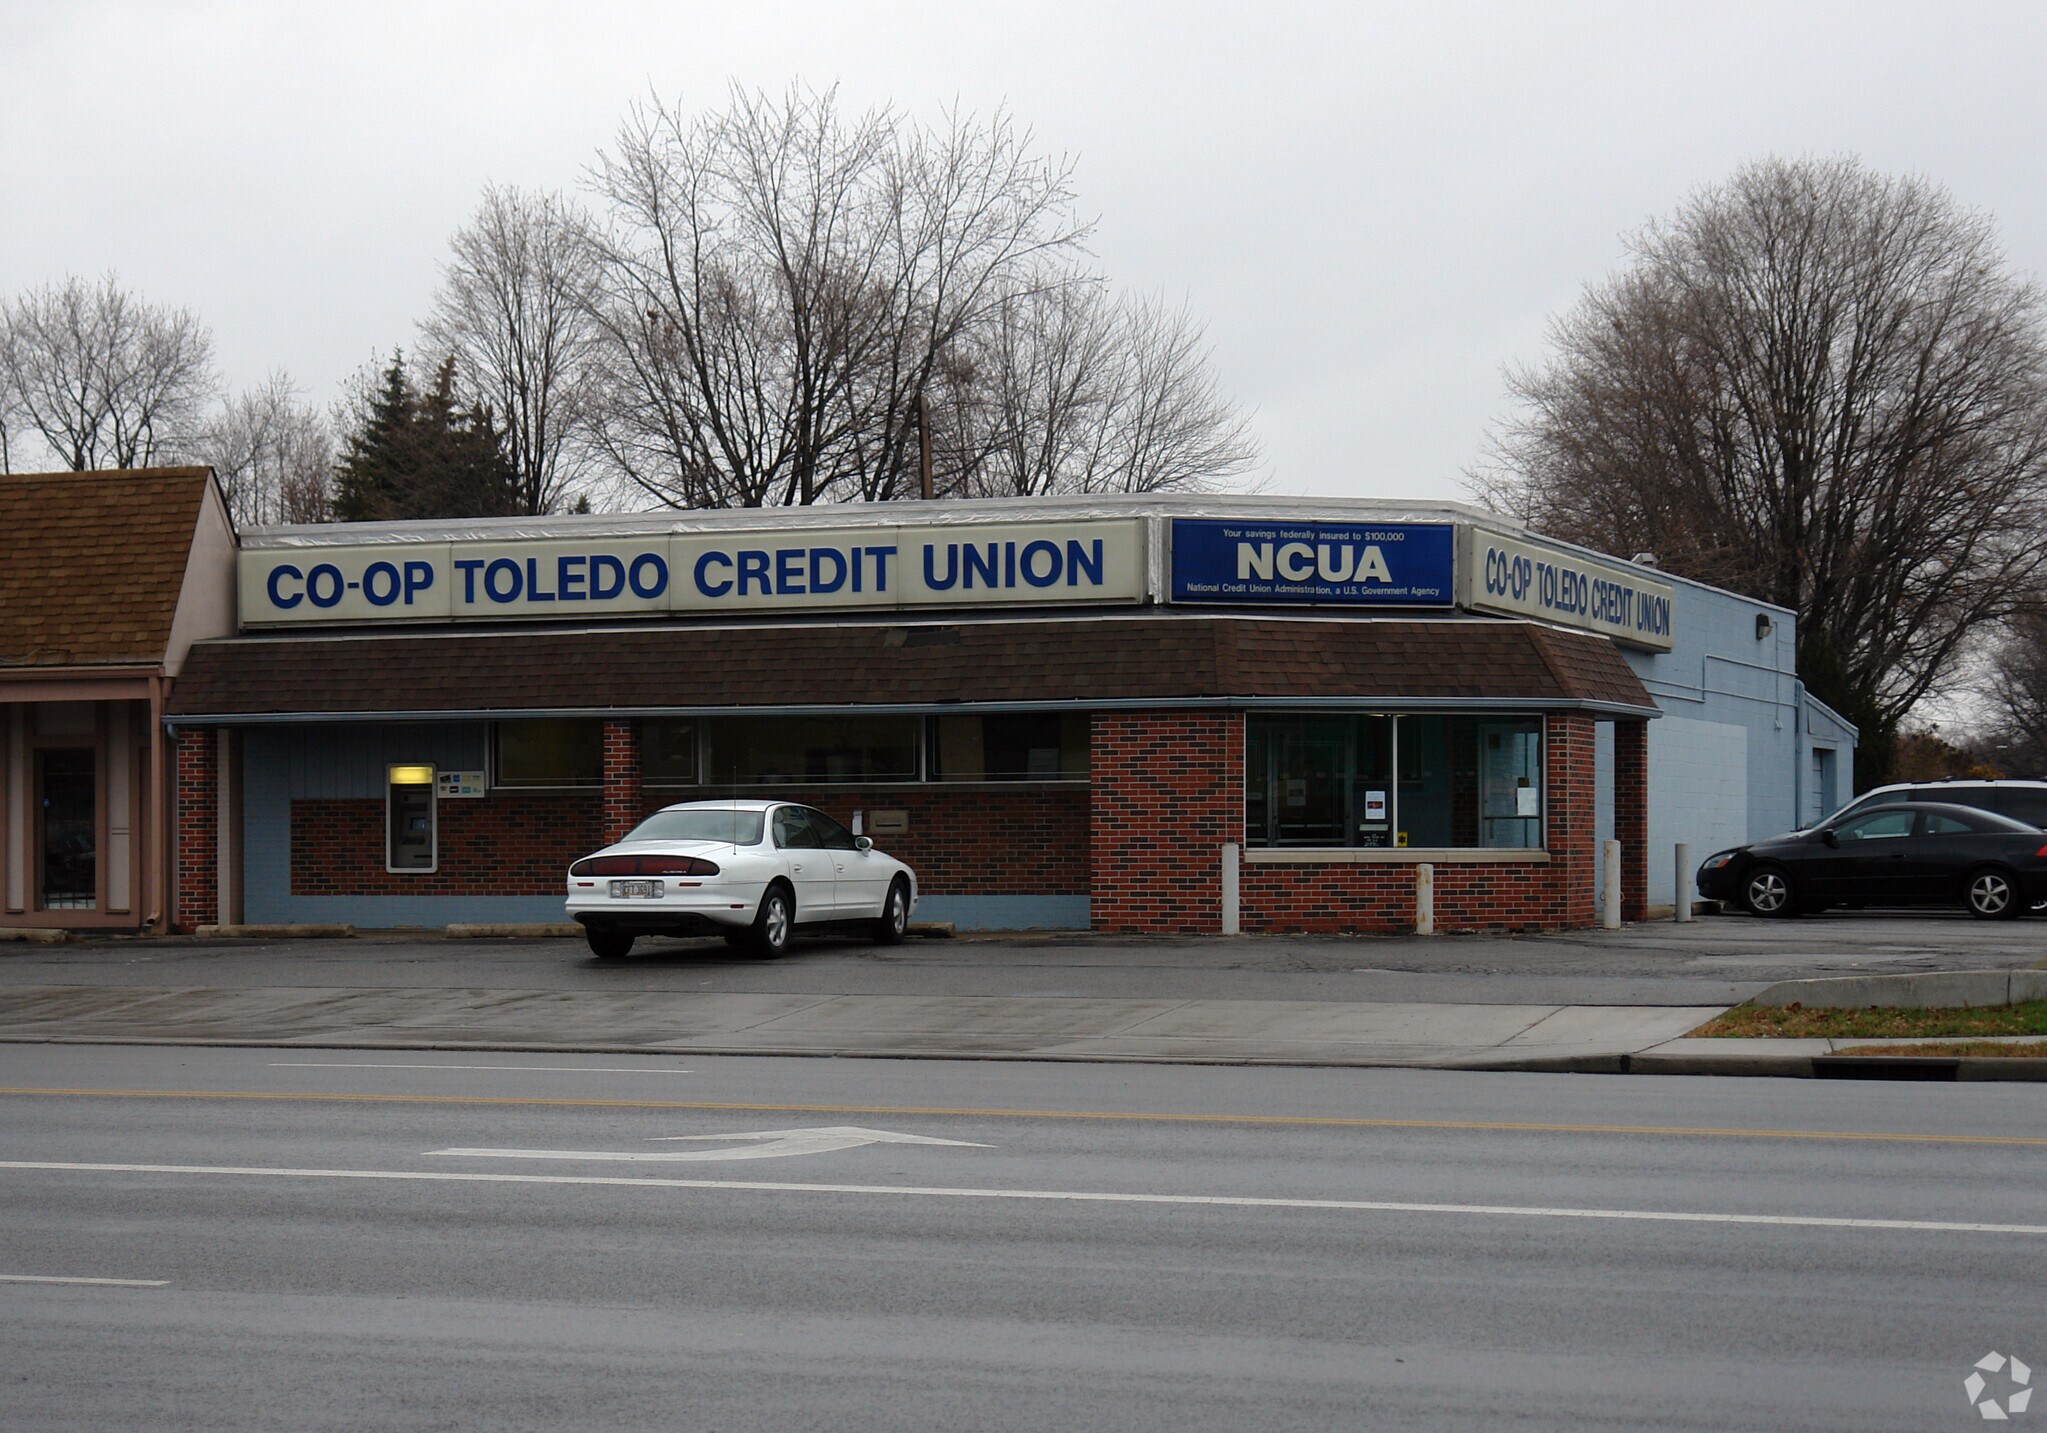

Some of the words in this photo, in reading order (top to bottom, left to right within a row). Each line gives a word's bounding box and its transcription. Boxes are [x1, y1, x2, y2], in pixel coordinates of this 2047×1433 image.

[1223, 529, 1241, 538] Your
[1245, 530, 1276, 540] savings
[1280, 530, 1315, 540] federally
[1319, 531, 1349, 540] insured
[1352, 532, 1361, 540] to
[1364, 532, 1405, 542] $100,000
[267, 561, 434, 609] CO-OP
[454, 553, 669, 603] TOLEDO
[693, 546, 897, 597] CREDIT
[922, 539, 1103, 591] UNION
[1237, 542, 1393, 583] NCUA
[1187, 583, 1219, 592] National
[1222, 583, 1246, 593] Credit
[1249, 584, 1272, 593] Union
[1274, 584, 1332, 595] Administration,
[1343, 586, 1359, 595] U.S.
[1361, 586, 1408, 595] Government
[1410, 587, 1440, 597] Agency
[1486, 547, 1532, 601] CO-OP
[1536, 562, 1588, 616] TOLEDO
[1592, 577, 1633, 627] CREDIT
[1637, 591, 1670, 636] UNION
